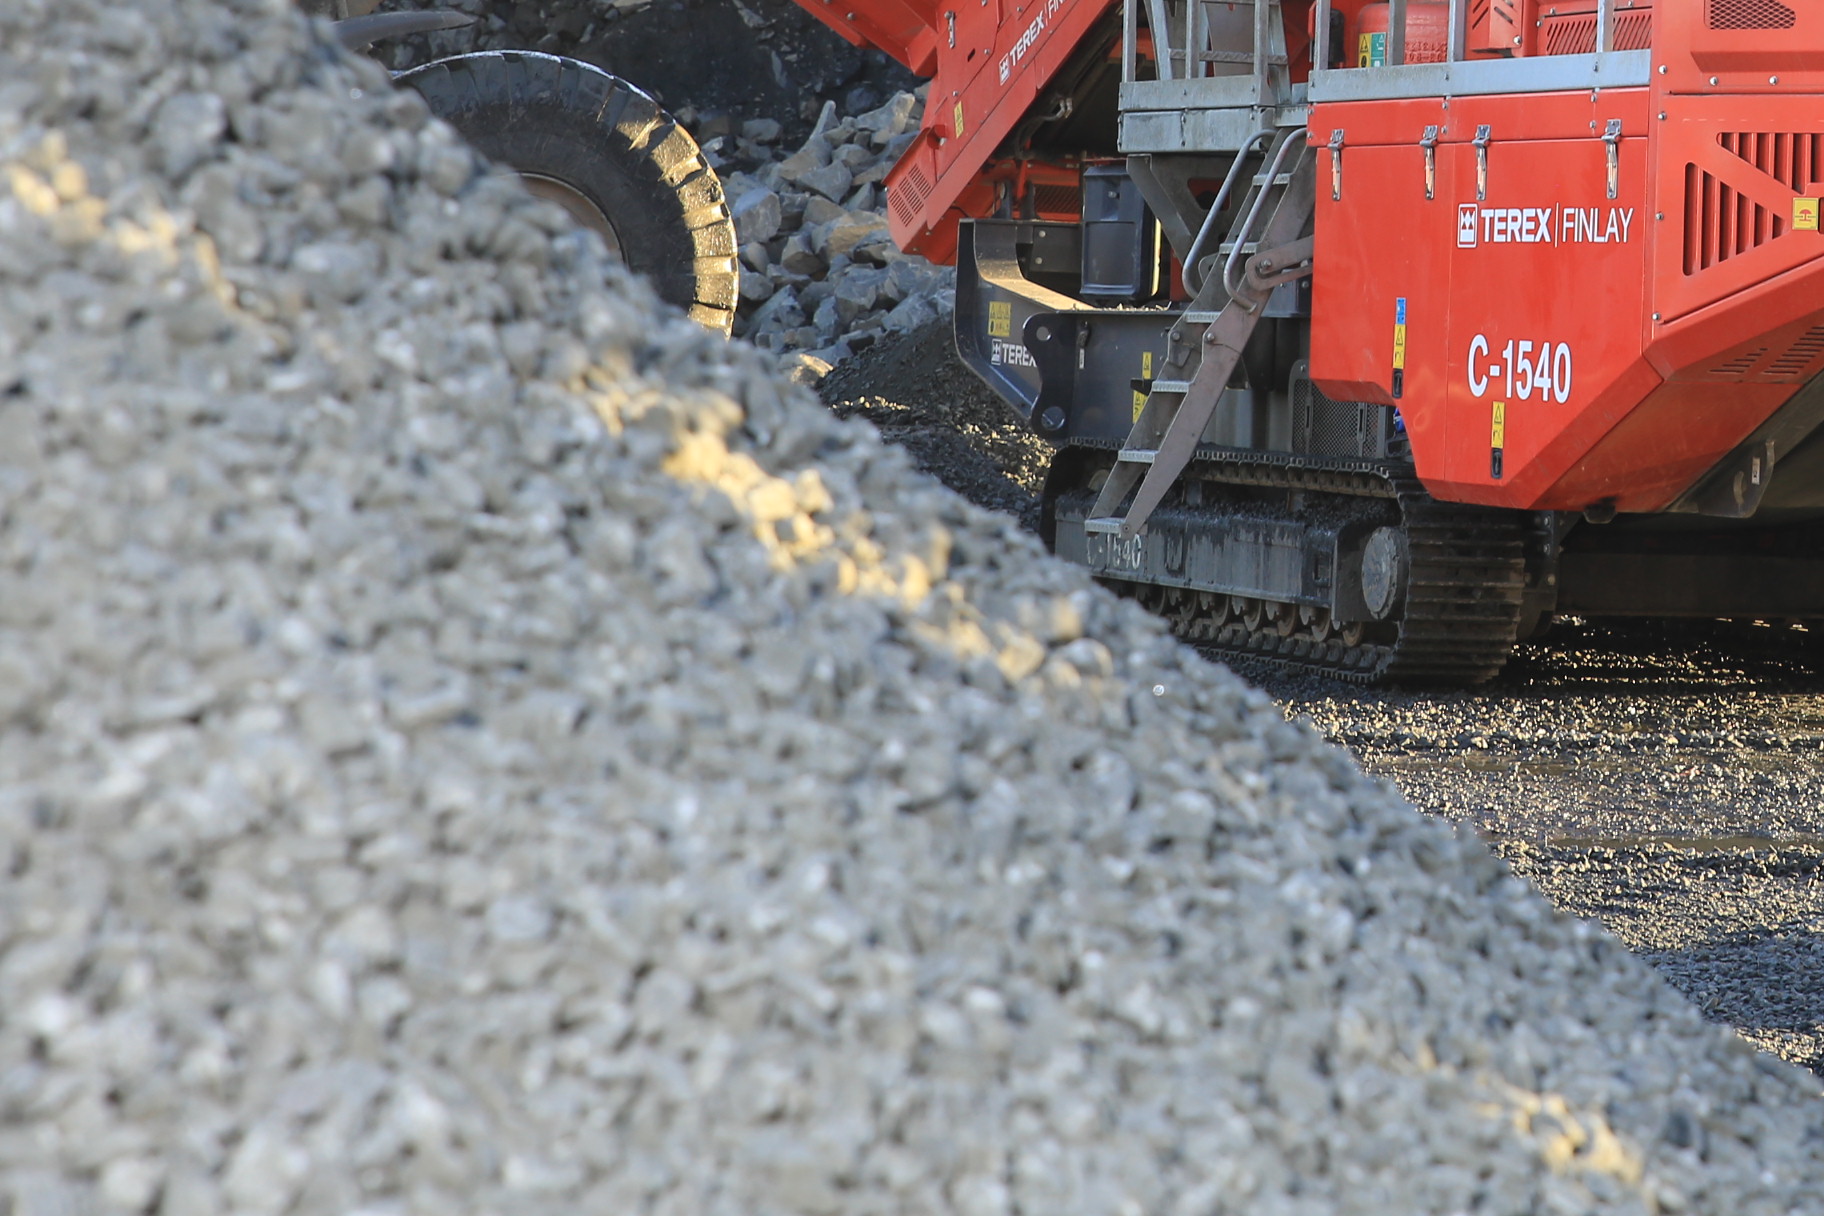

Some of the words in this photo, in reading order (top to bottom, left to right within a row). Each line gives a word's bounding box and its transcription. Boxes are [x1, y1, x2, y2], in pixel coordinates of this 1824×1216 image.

[1009, 10, 1044, 67] TEREX
[1480, 207, 1552, 243] TEREX
[1562, 207, 1634, 243] FINLAY
[1467, 333, 1573, 404] C-1540
